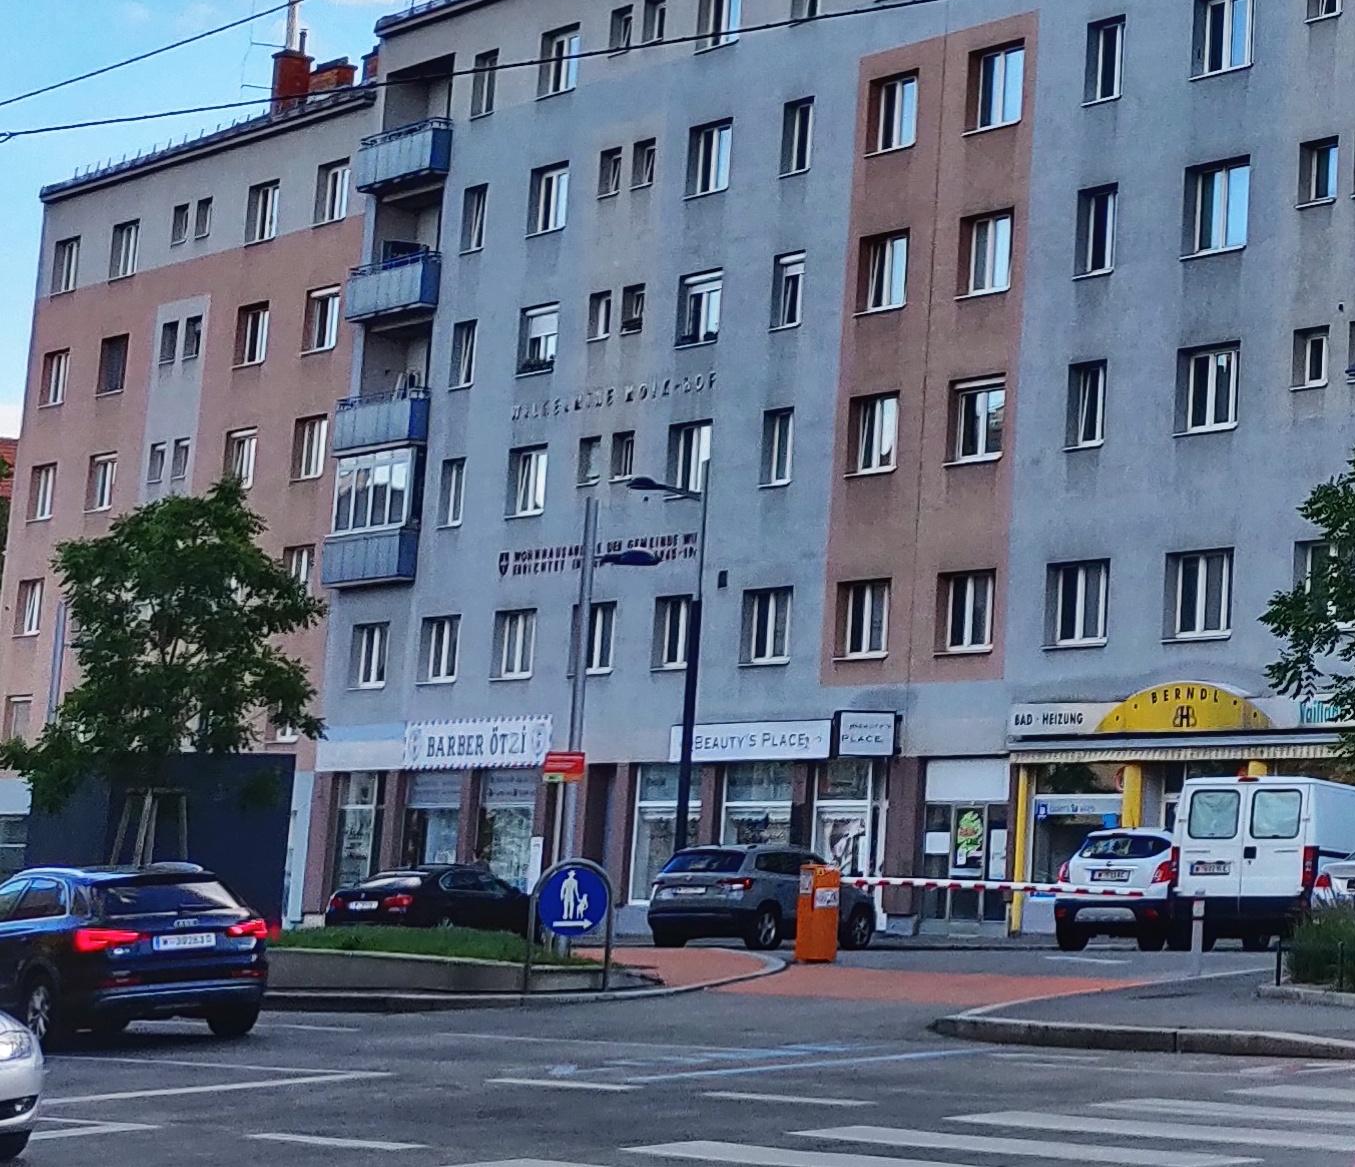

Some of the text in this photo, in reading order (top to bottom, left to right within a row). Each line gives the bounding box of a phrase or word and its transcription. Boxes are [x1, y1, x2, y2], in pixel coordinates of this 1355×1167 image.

[1151, 686, 1220, 704] BERNDL
[1014, 711, 1084, 726] BAD HEIZUNG
[426, 734, 484, 758] BARBER
[694, 732, 806, 750] BEAUTY'S PLACE
[841, 734, 883, 743] PLACE
